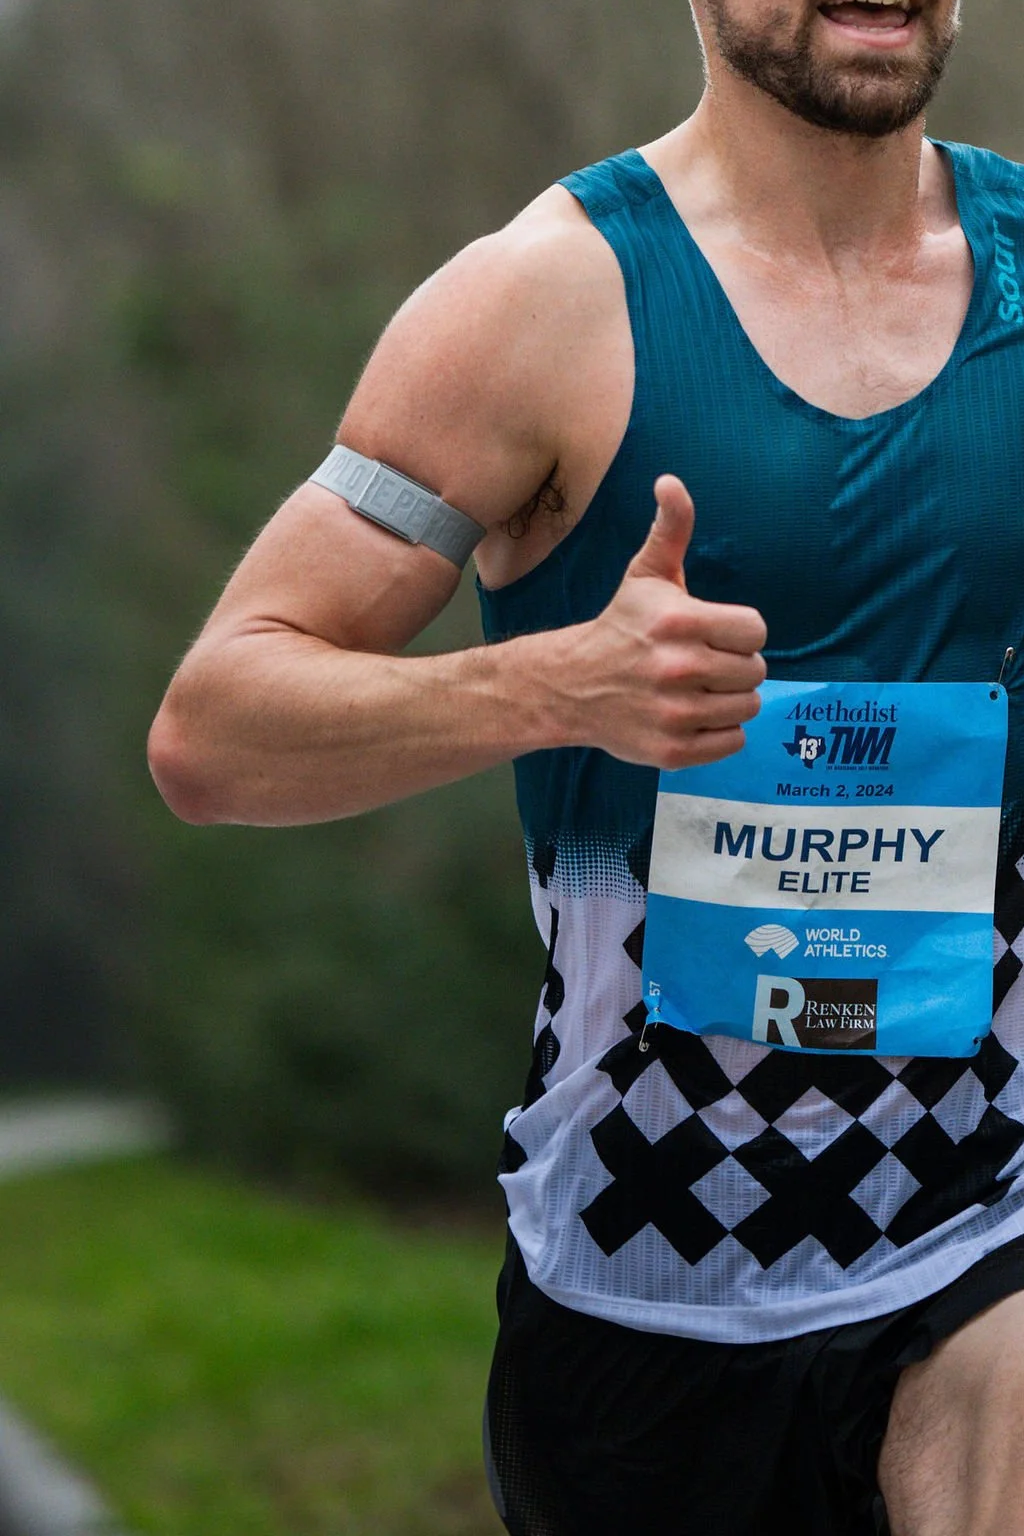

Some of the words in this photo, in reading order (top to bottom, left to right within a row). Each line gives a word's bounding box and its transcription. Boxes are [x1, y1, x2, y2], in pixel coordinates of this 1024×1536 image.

[992, 218, 1024, 323] soar
[784, 700, 898, 722] Methodist
[776, 783, 830, 797] March
[835, 785, 849, 800] 2,
[855, 785, 894, 797] 2024
[713, 821, 945, 863] MURPHY
[778, 870, 871, 894] ELITE
[805, 928, 860, 942] WORLD
[803, 944, 887, 958] ATHLETICS
[752, 974, 805, 1048] R
[805, 1000, 876, 1017] RENKEN
[840, 1017, 875, 1029] FIRM
